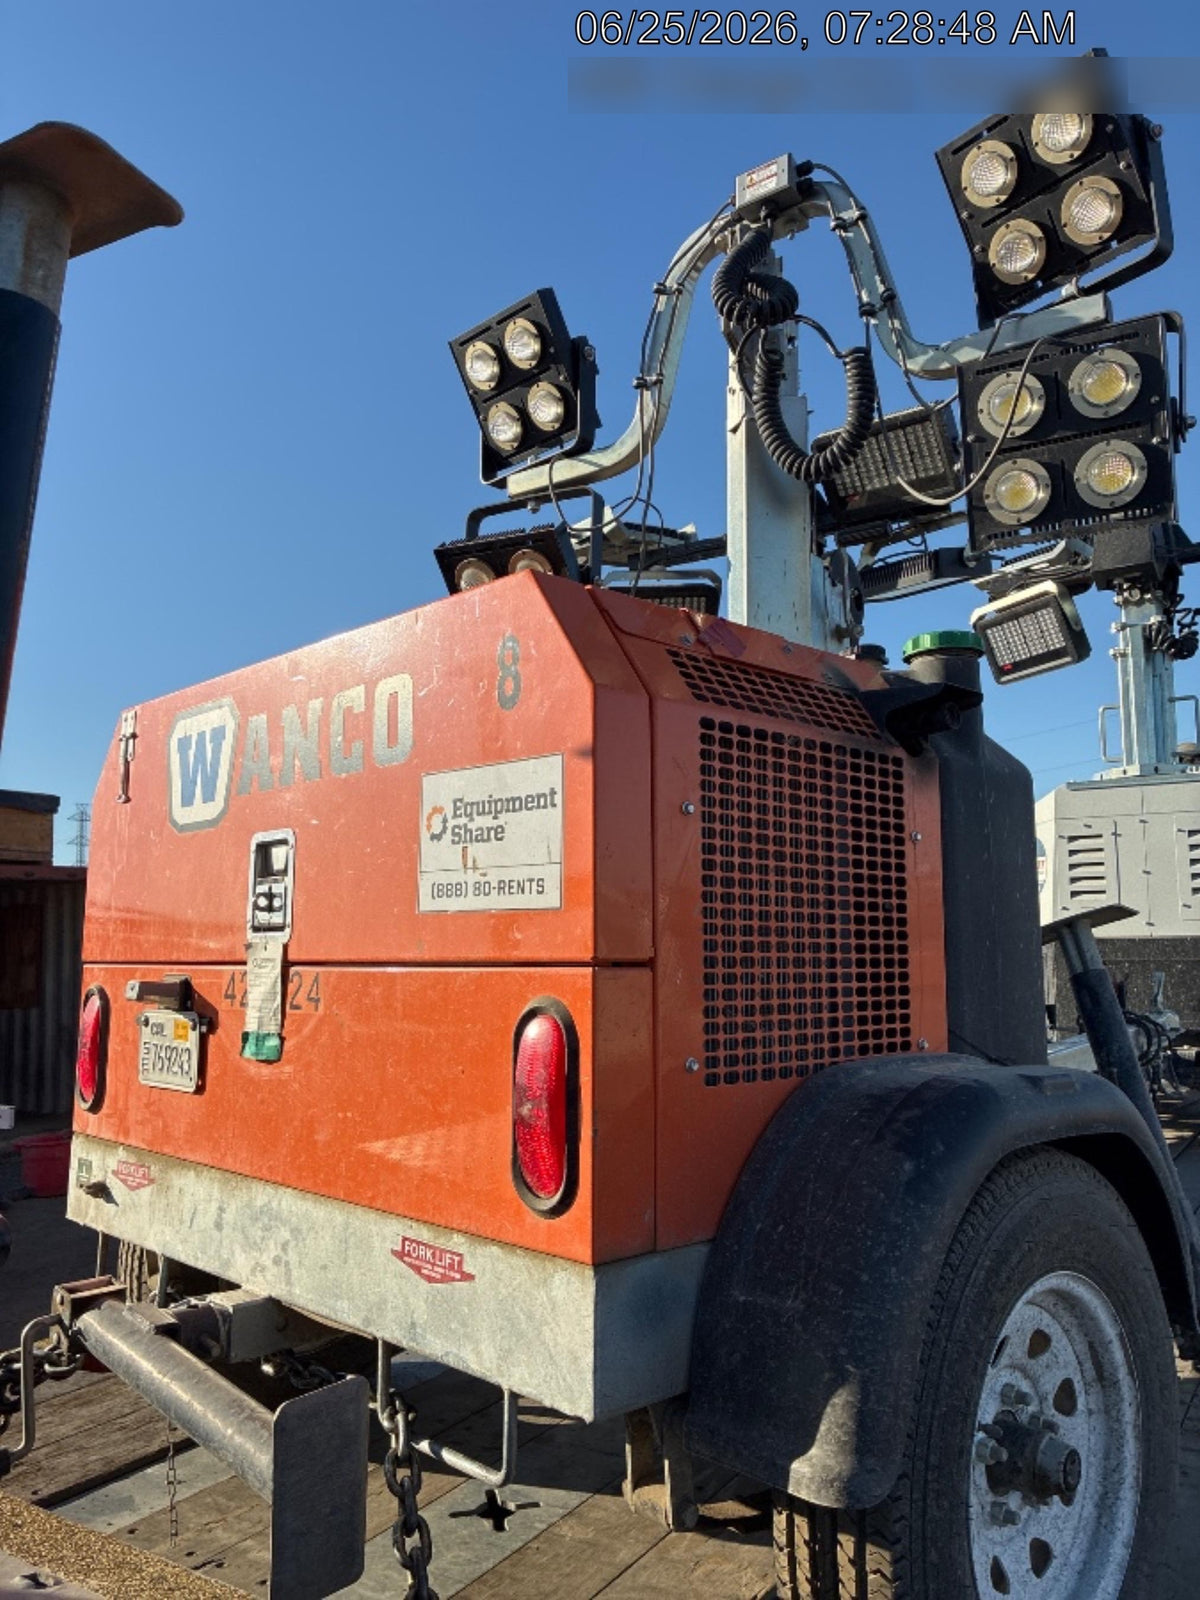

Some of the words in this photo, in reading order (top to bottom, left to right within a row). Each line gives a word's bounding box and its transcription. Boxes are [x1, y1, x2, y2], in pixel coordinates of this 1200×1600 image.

[497, 633, 522, 711] 8
[173, 673, 414, 820] WANCO
[451, 787, 558, 822] Equipment
[451, 823, 506, 846] Share
[404, 1240, 434, 1263] FORK
[434, 1250, 461, 1271] LIFT
